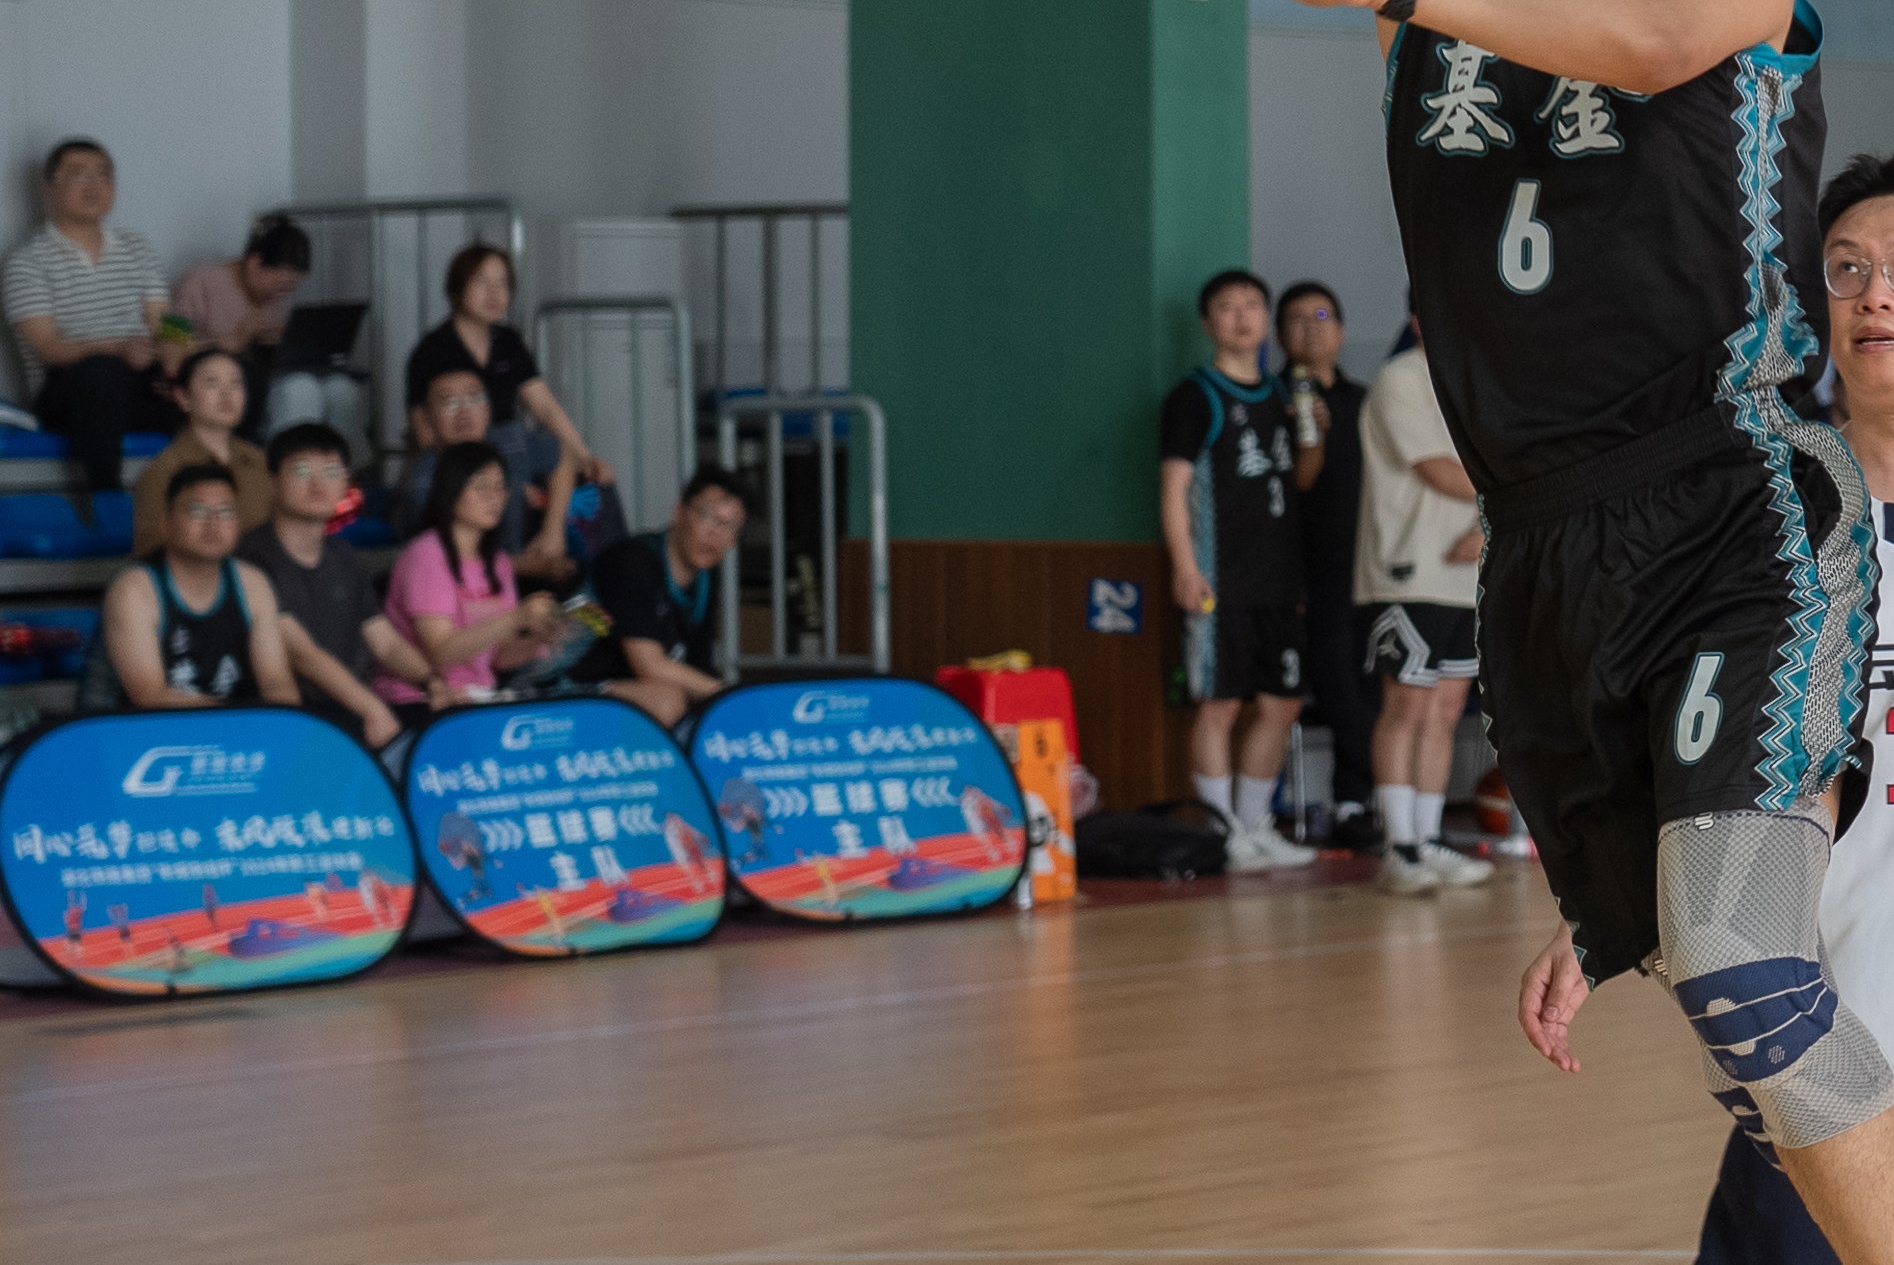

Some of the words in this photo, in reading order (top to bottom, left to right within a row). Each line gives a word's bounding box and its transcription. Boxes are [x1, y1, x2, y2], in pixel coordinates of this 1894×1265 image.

[1416, 38, 1655, 158] 基金
[1498, 178, 1554, 295] 6
[1092, 579, 1139, 632] 24
[1673, 651, 1725, 766] 6
